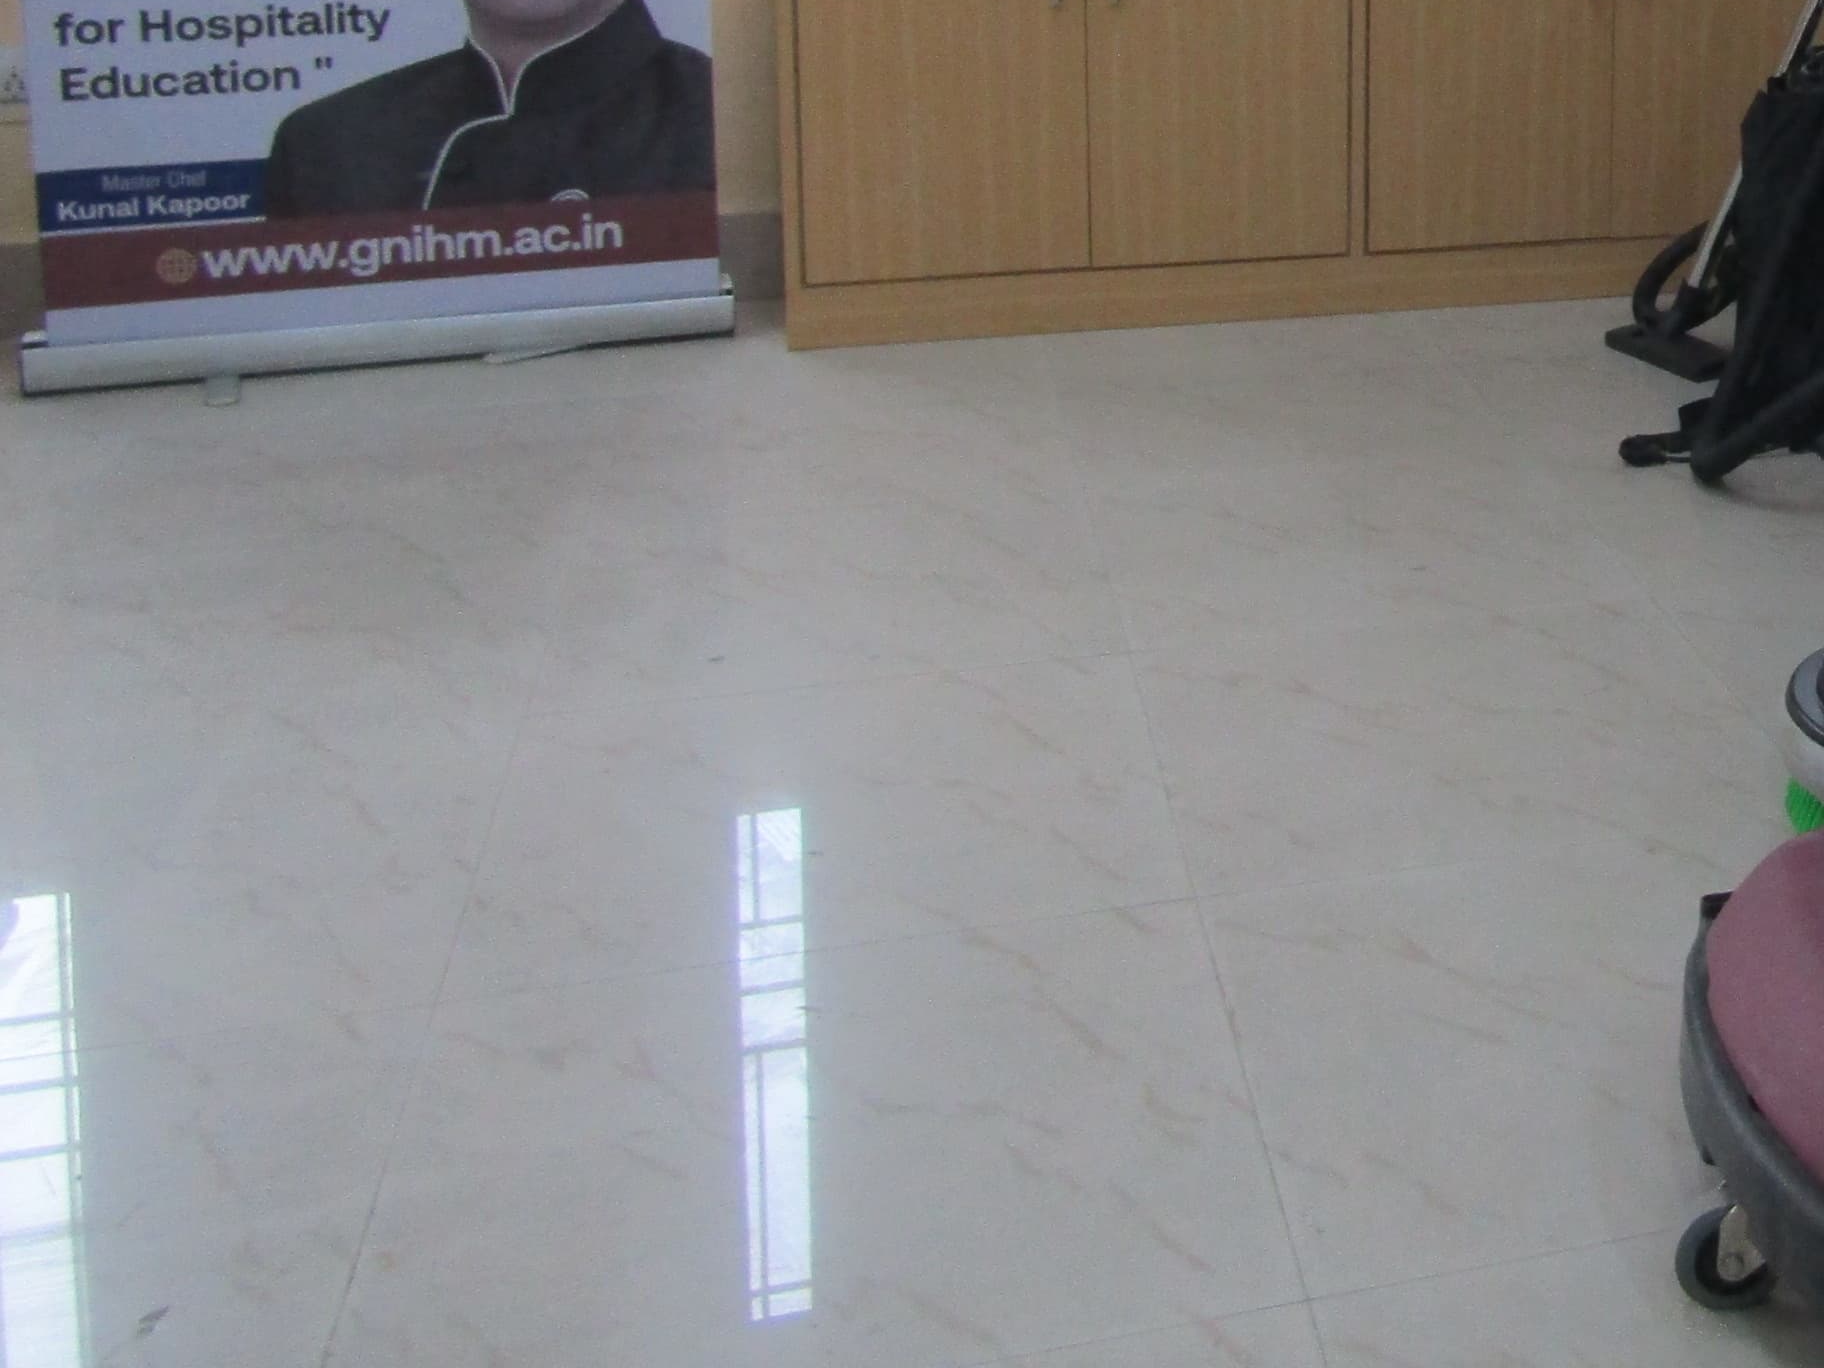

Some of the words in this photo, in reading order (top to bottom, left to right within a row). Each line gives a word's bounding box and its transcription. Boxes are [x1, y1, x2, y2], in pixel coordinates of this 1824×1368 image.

[54, 10, 125, 46] for
[140, 3, 391, 47] Hospitality
[60, 60, 300, 102] Education
[103, 169, 160, 191] Master
[57, 196, 139, 223] Kunal
[147, 190, 251, 220] Kapoor
[203, 213, 623, 279] www.gnihm.ac.in
